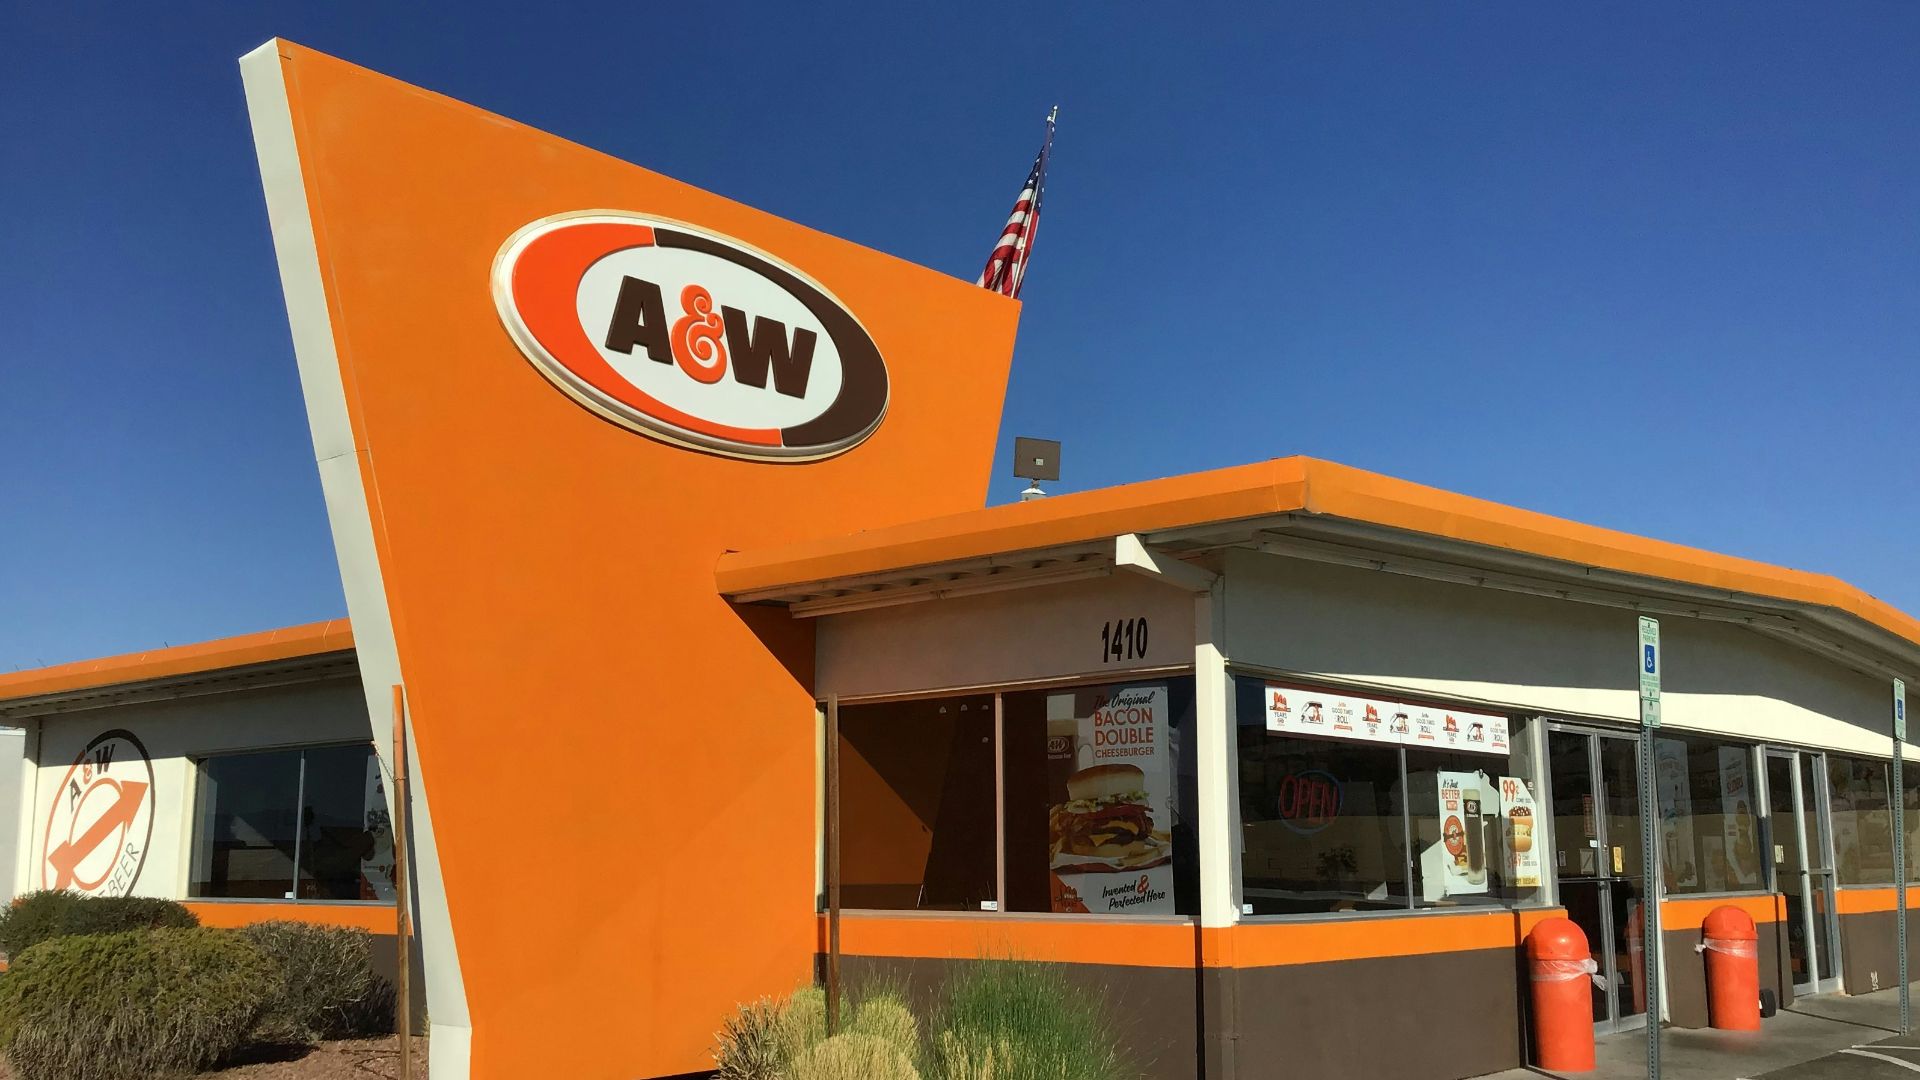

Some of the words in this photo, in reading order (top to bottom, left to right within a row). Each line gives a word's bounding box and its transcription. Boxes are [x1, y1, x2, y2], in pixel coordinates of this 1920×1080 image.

[604, 274, 818, 400] A&W
[1102, 617, 1148, 663] 1410
[1111, 691, 1155, 711] Original
[1094, 708, 1153, 727] BACON
[1095, 727, 1154, 747] DOUBLE
[1095, 747, 1154, 758] CHEESEBURGER
[1280, 774, 1338, 825] OPEN
[1441, 789, 1460, 800] BETTER
[1102, 880, 1137, 898] Invented
[1137, 875, 1149, 893] &
[1108, 890, 1146, 910] Perfected
[1146, 890, 1166, 903] Here
